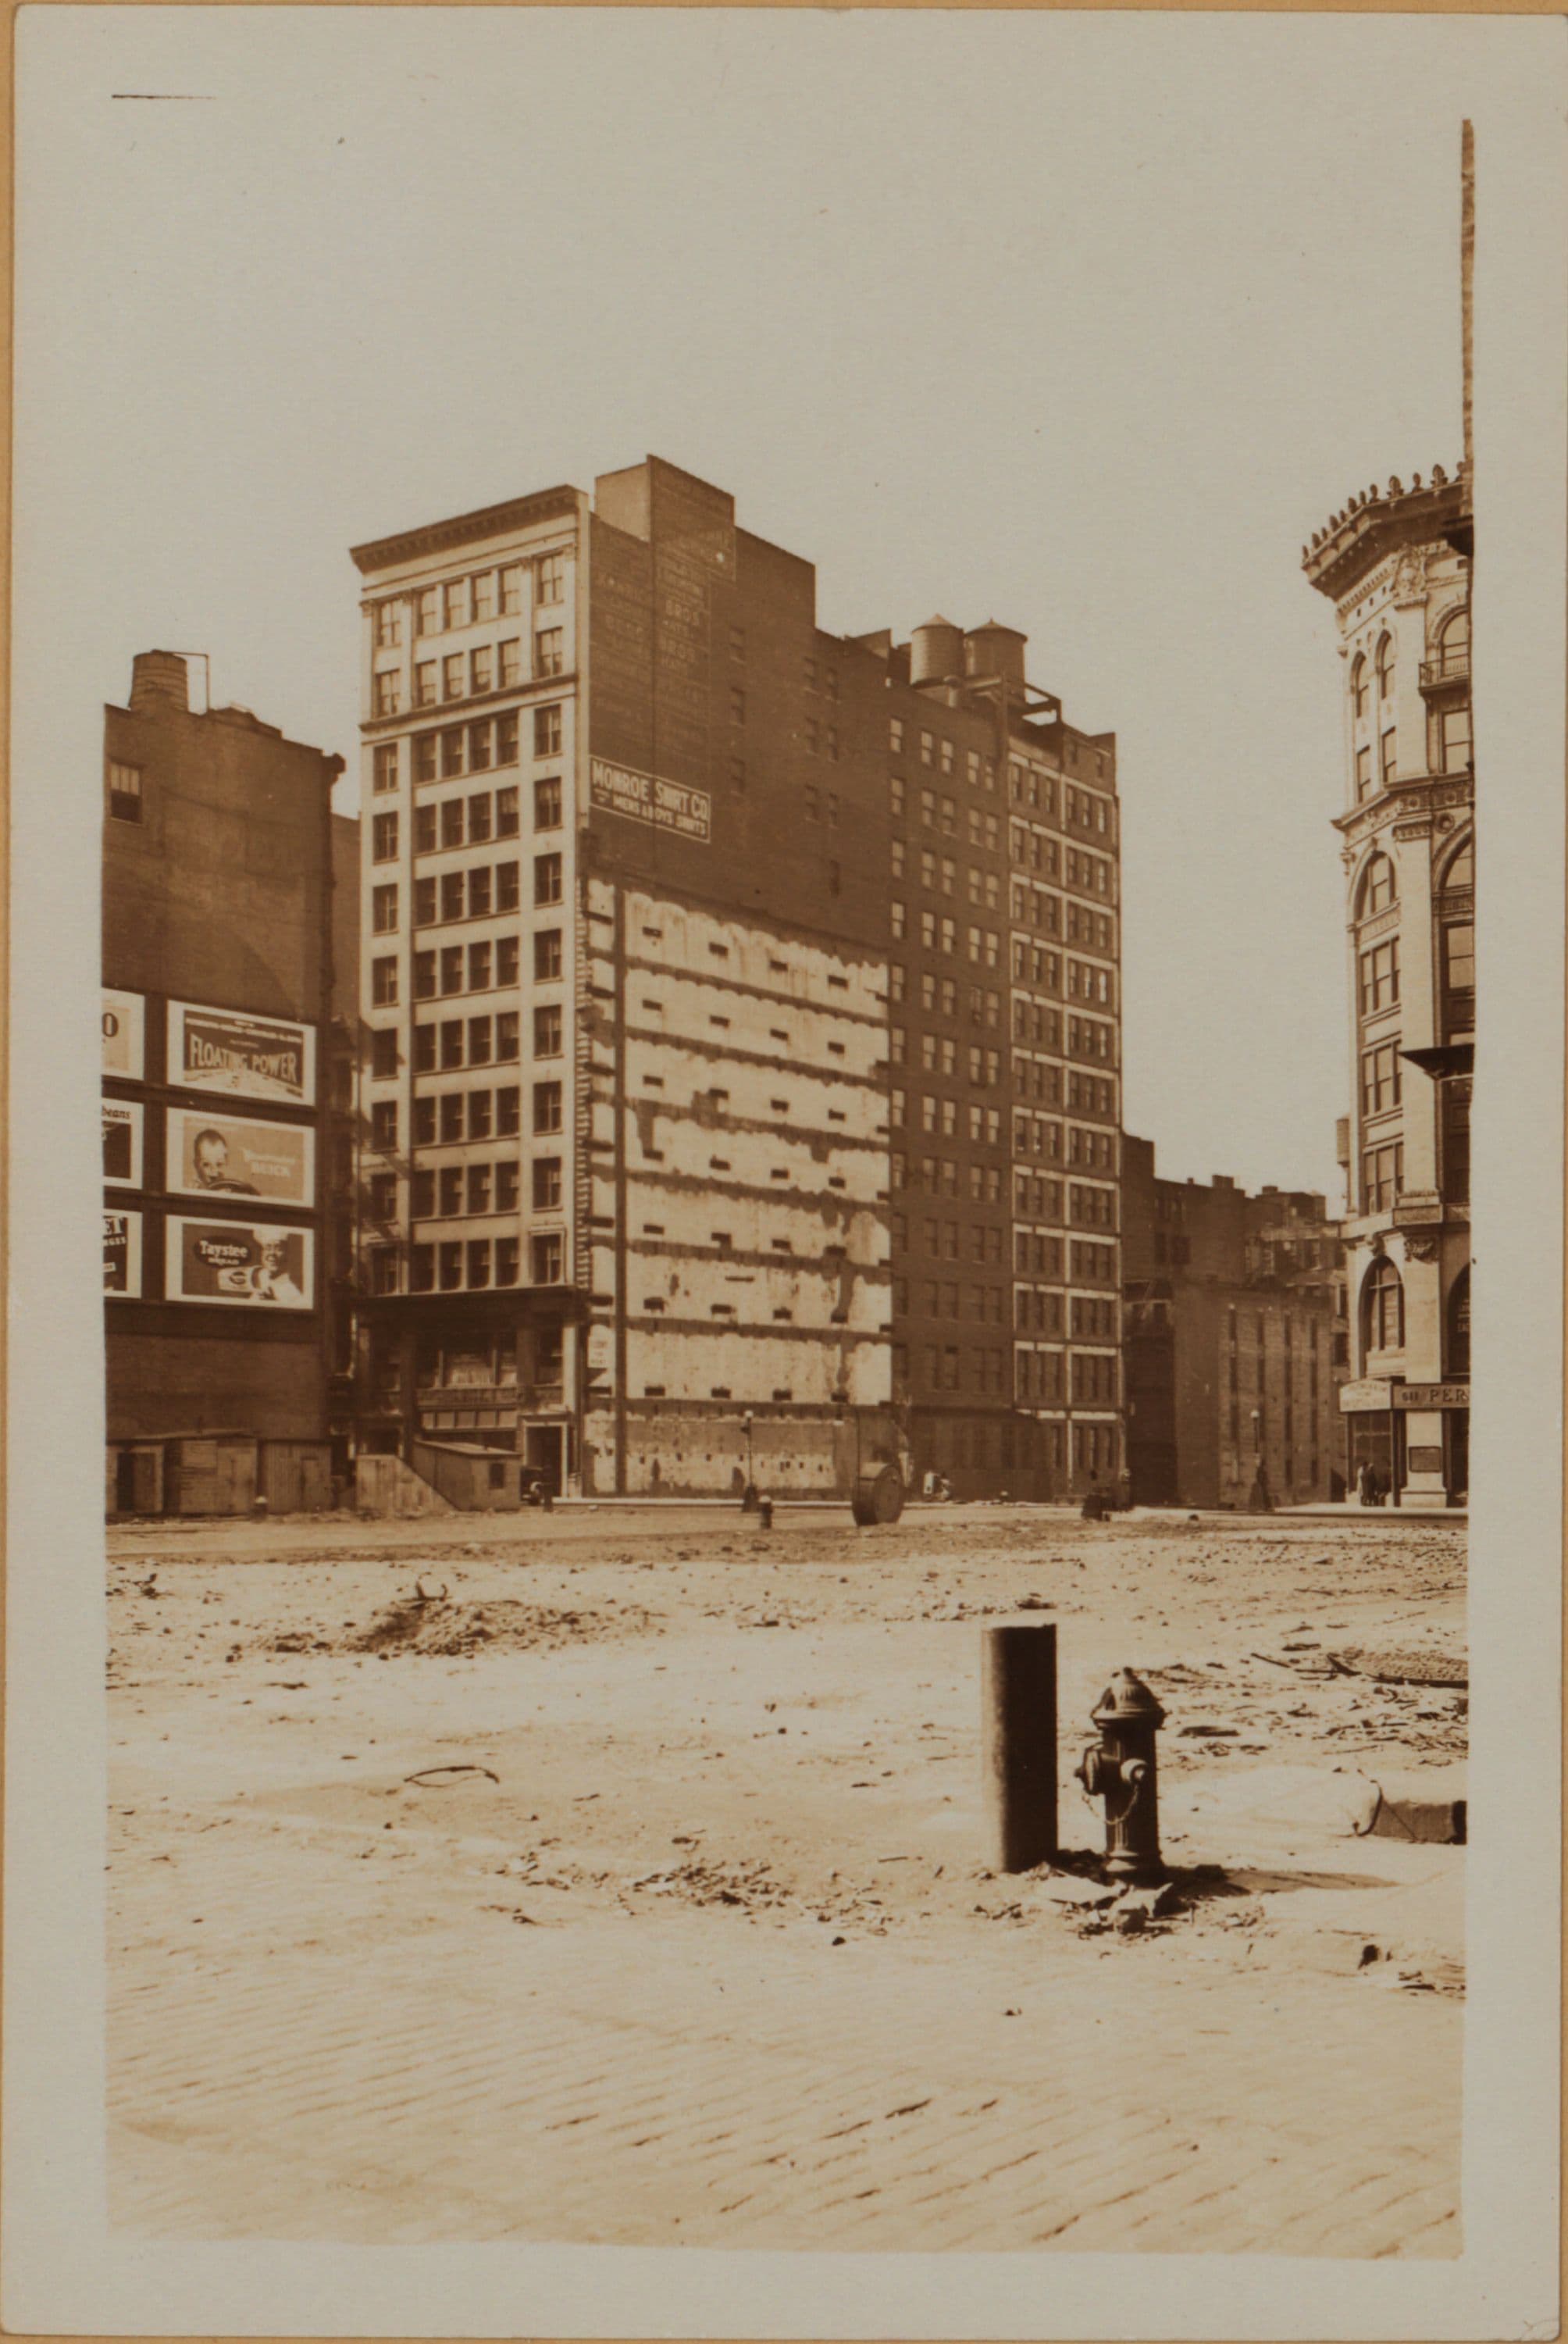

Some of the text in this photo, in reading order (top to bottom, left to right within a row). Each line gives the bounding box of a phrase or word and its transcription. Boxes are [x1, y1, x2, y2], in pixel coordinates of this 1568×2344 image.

[592, 760, 650, 802] MONROE
[654, 781, 690, 814] SHIRT
[190, 1033, 298, 1083] FLOATING POWER
[102, 1104, 132, 1119] beans
[199, 1240, 248, 1258] Taystee
